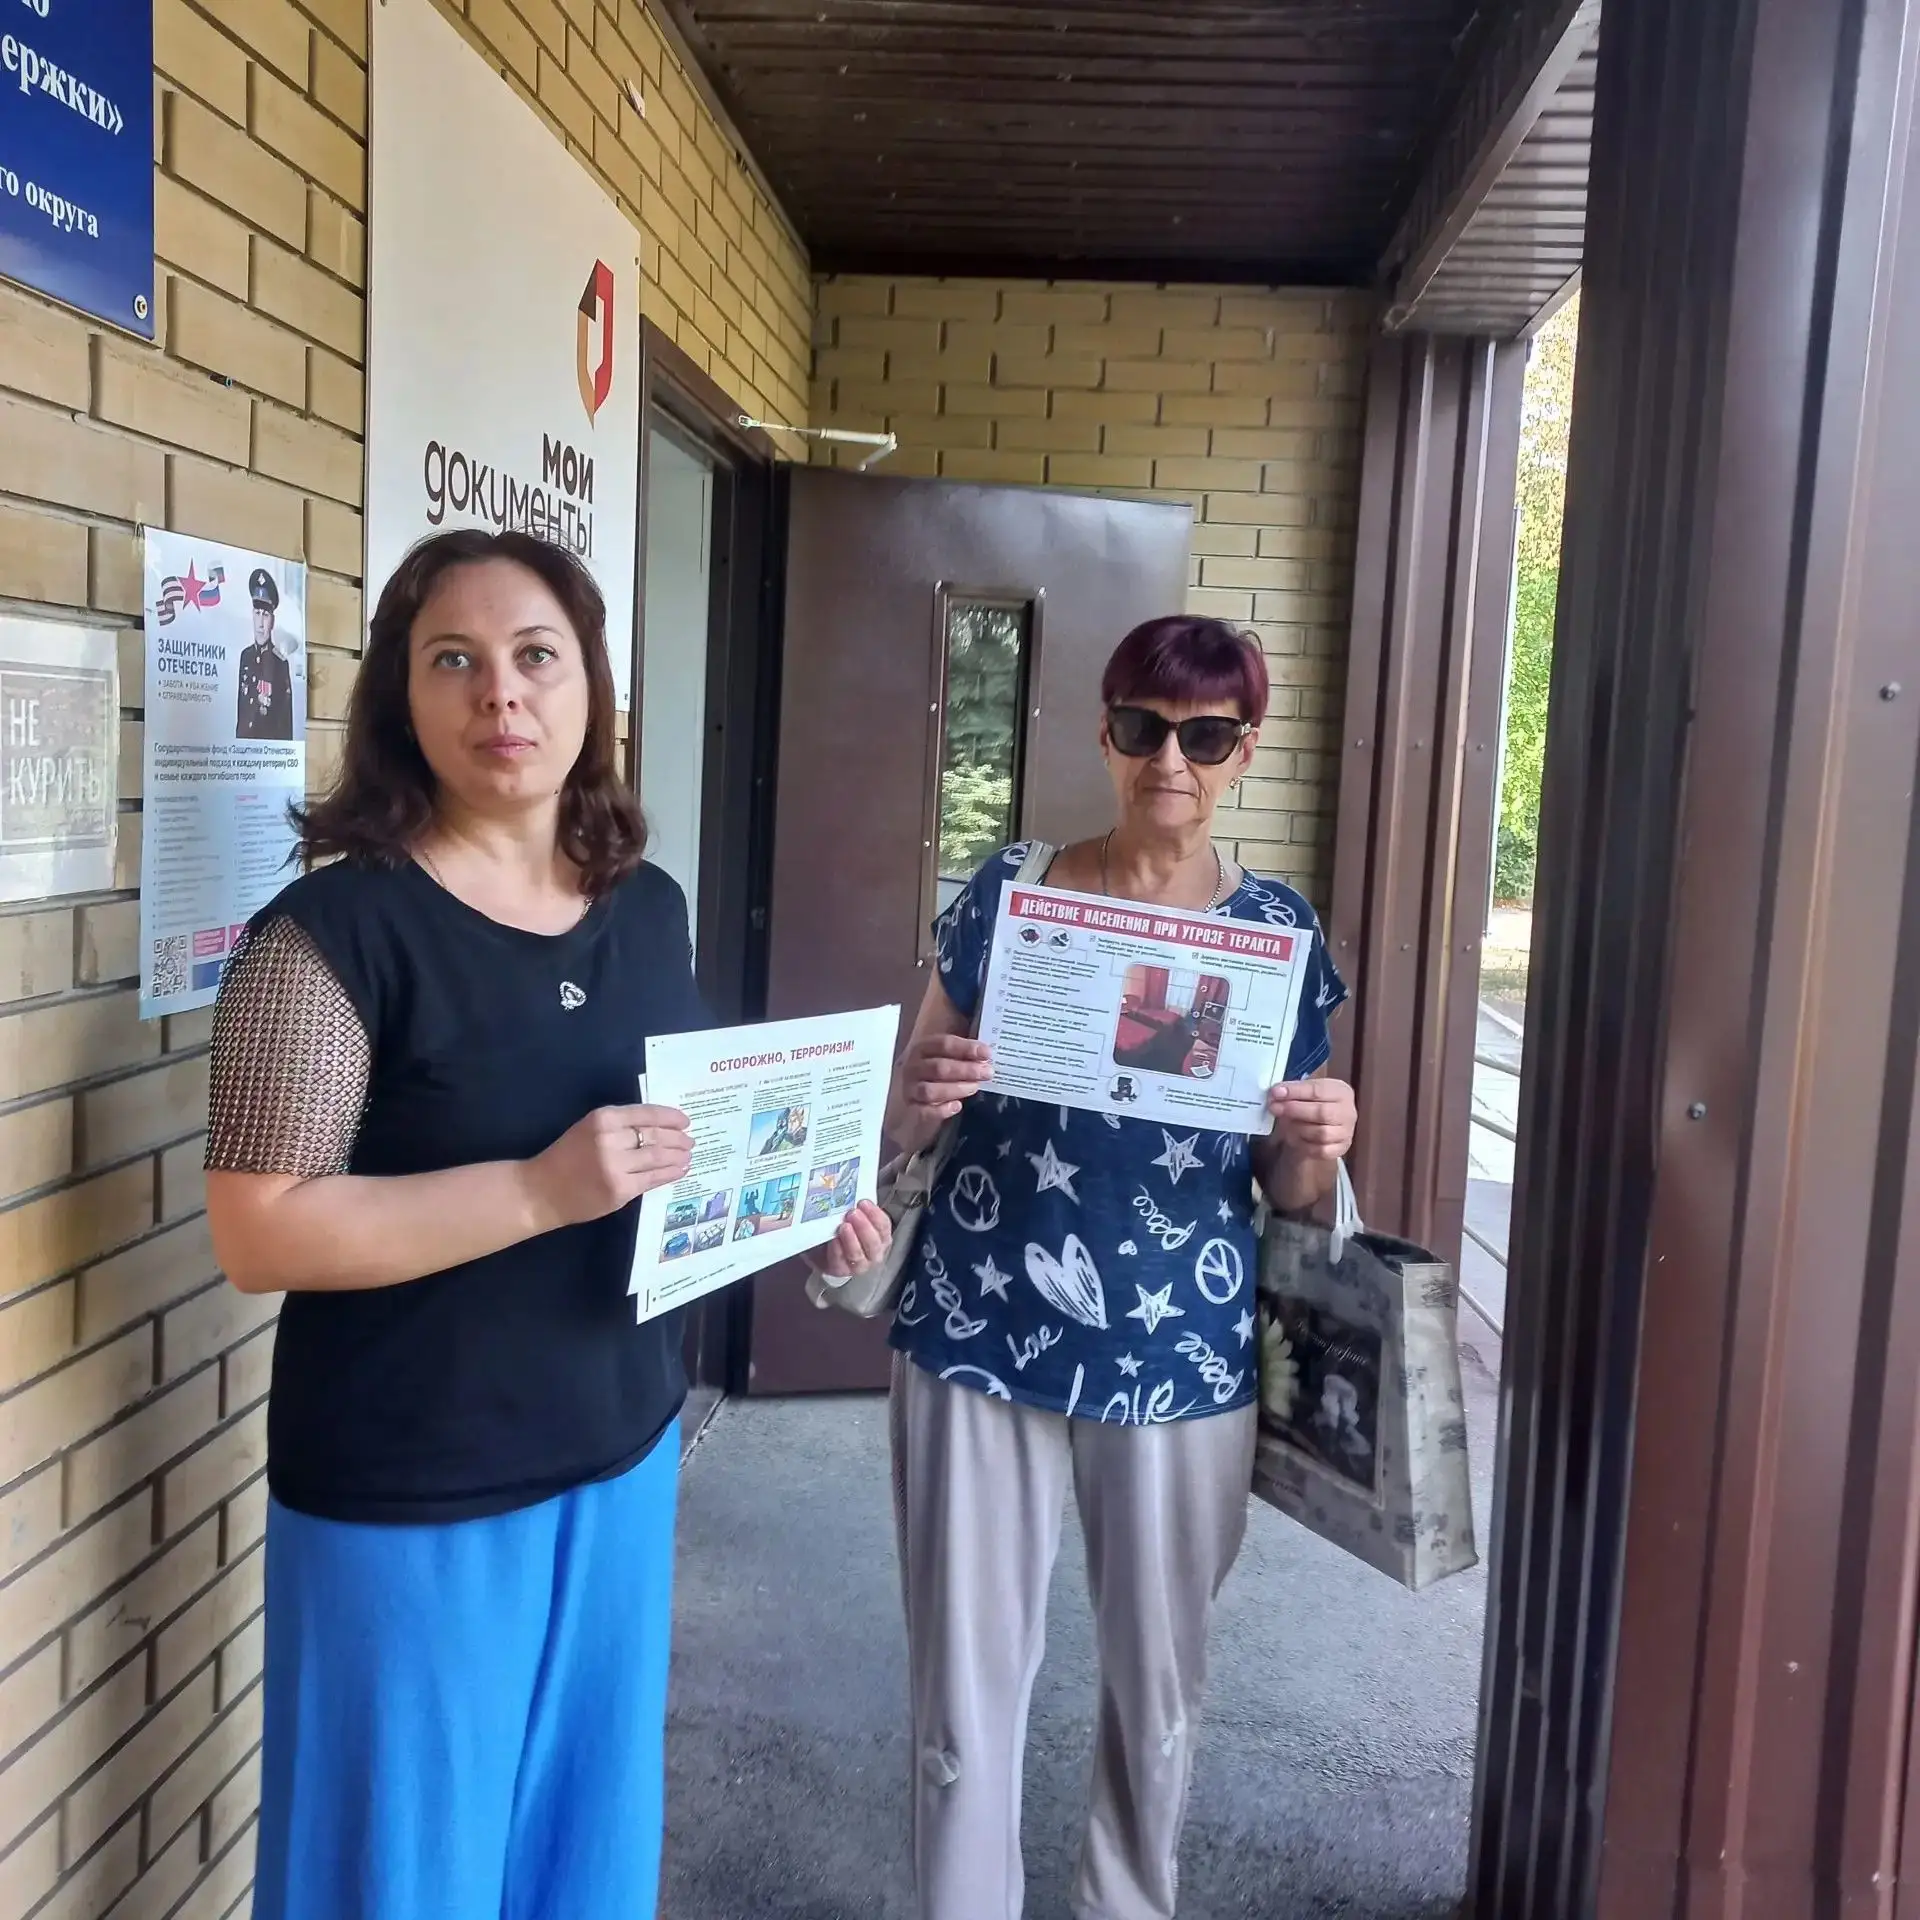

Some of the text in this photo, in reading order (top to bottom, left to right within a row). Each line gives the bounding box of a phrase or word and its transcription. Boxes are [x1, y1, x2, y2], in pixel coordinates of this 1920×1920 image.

[25, 181, 100, 239] округа
[542, 432, 594, 505] мои
[424, 440, 594, 559] документы
[158, 638, 226, 661] ЗАЩИТНИКИ
[158, 657, 219, 678] ОТЕЧЕСТВА
[9, 698, 41, 747] НЕ
[9, 756, 101, 806] КУРИТЬ
[1019, 897, 1282, 956] ДЕЙСТВИЕ НАСЕЛЕНИЯ ПРИ УГРОЗЕ ТЕРАКТА
[710, 1040, 855, 1074] ОСТОРОЖНО, ТЕРРОРИЗМ!
